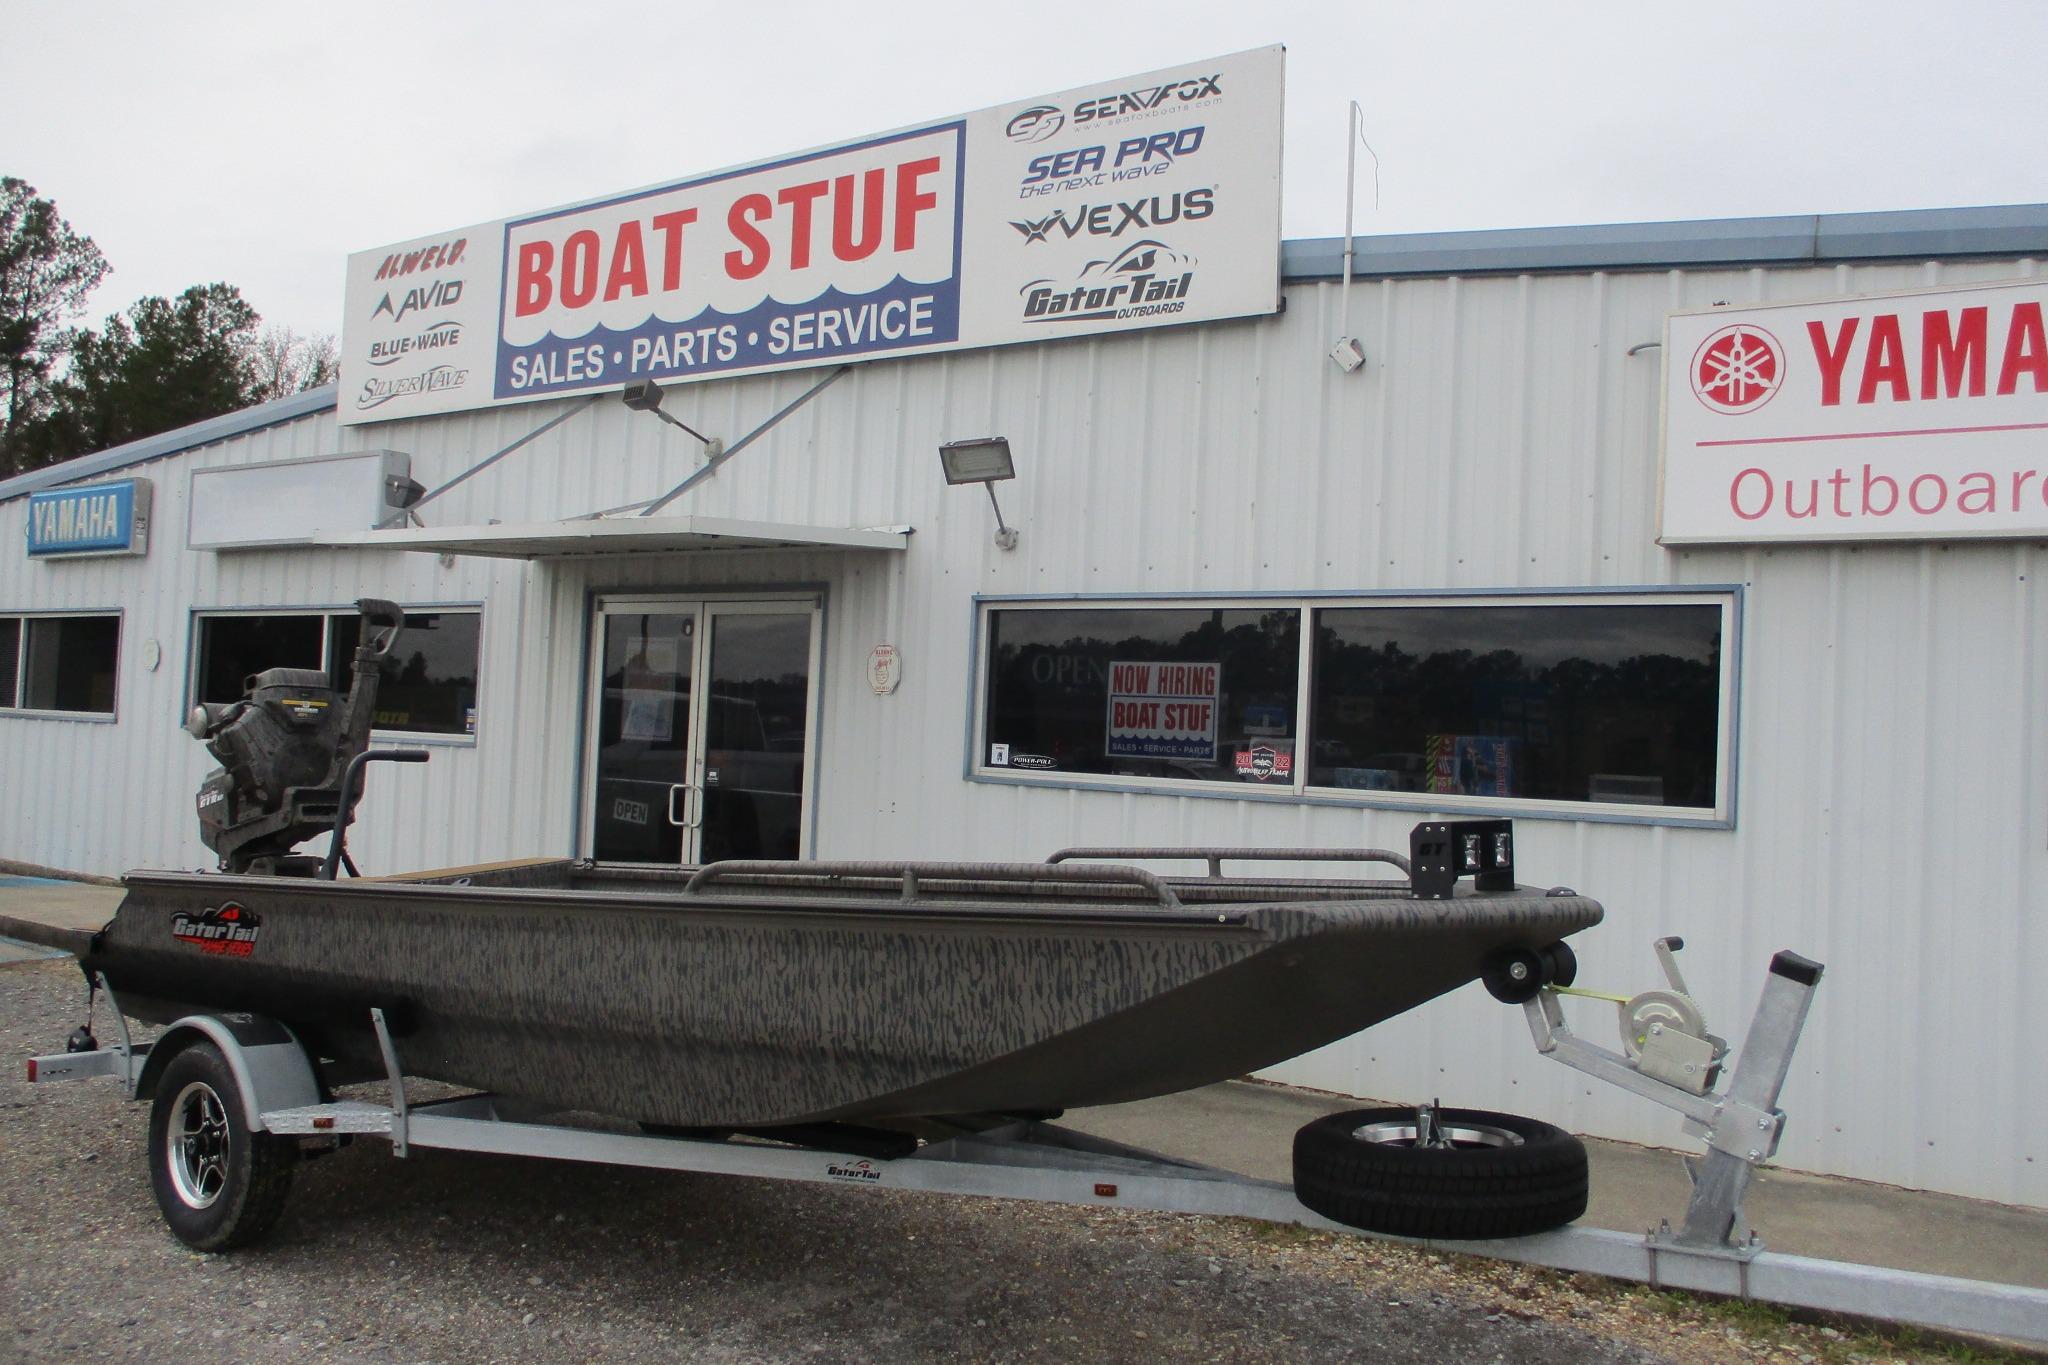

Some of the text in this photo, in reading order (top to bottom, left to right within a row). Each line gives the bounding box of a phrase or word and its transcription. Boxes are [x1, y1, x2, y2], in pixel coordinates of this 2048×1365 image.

[1021, 126, 1205, 185] SEA PRO
[1020, 161, 1168, 199] the next wave
[1054, 188, 1214, 238] VEXUS
[515, 156, 940, 317] BOAT STUF
[374, 237, 467, 281] ALWELD
[395, 280, 463, 322] AVID
[1024, 272, 1192, 317] GatorTail
[1118, 301, 1184, 319] OUTBOARDS
[370, 329, 460, 358] BLUE WAVE
[510, 295, 934, 390] SALES PARTS SERVICE
[34, 494, 118, 544] YAMAHA
[1113, 665, 1215, 696] NOW HIRING
[1113, 702, 1211, 731] BOAT STUF
[1112, 743, 1211, 755] SALES SERVICE PARTS
[1236, 755, 1289, 767] 20 22
[616, 801, 648, 822] OPEN
[173, 918, 260, 942] GatorTail
[828, 1166, 880, 1179] GatorTail
